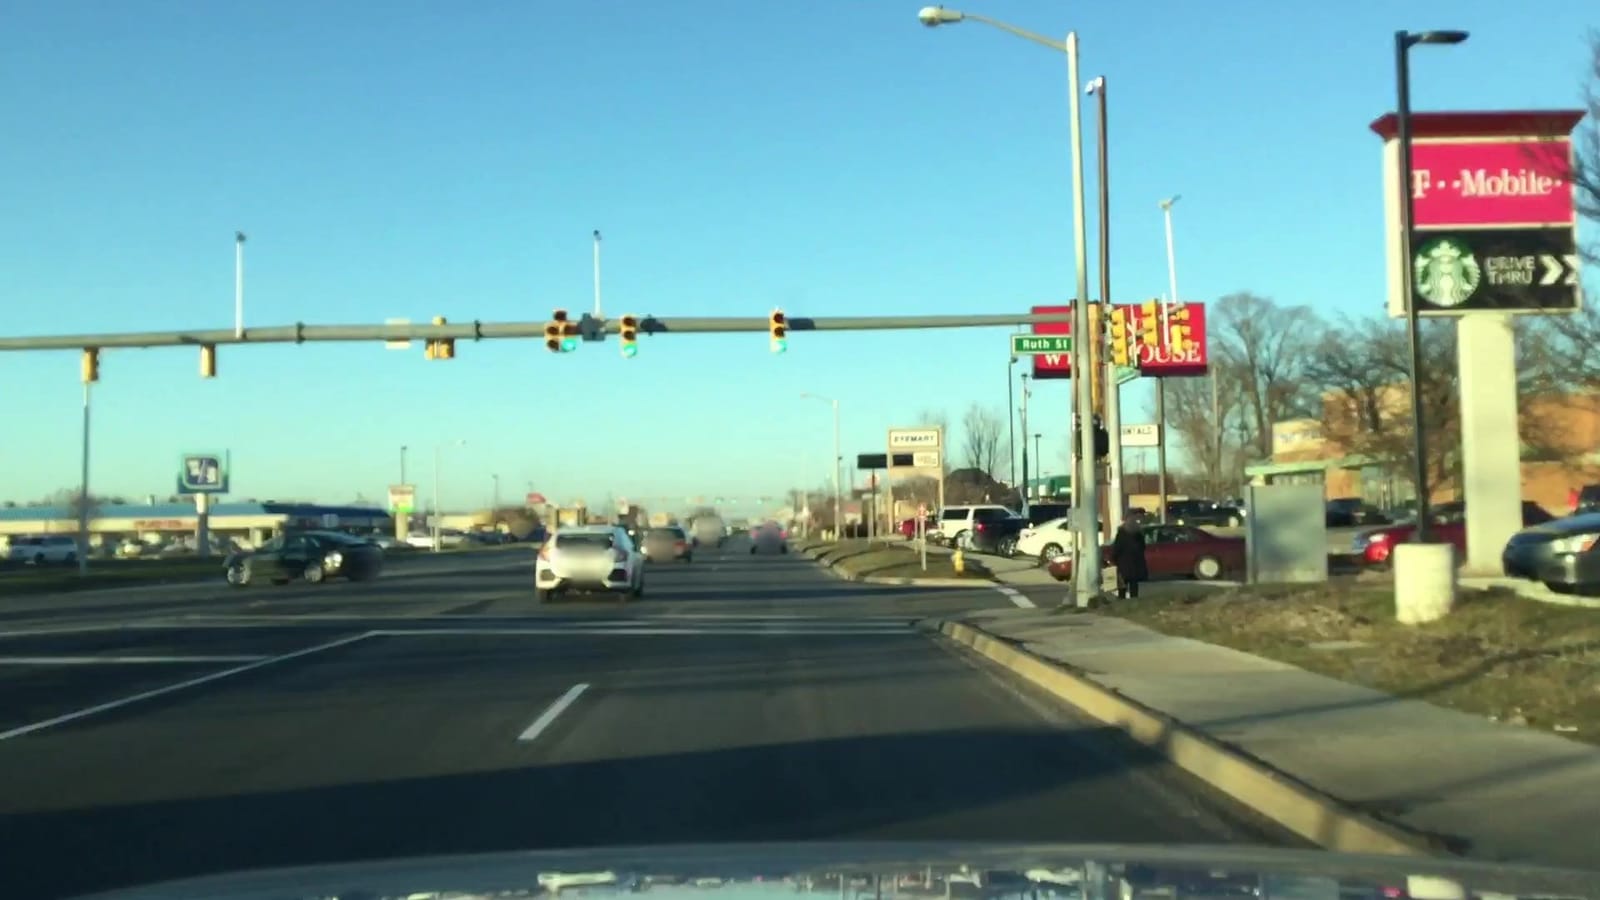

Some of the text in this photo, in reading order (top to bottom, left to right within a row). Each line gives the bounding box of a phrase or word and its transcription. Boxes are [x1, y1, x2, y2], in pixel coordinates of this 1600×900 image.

[1484, 256, 1535, 270] DRIVE
[1488, 270, 1532, 285] THRU
[1022, 338, 1068, 349] Ruth St
